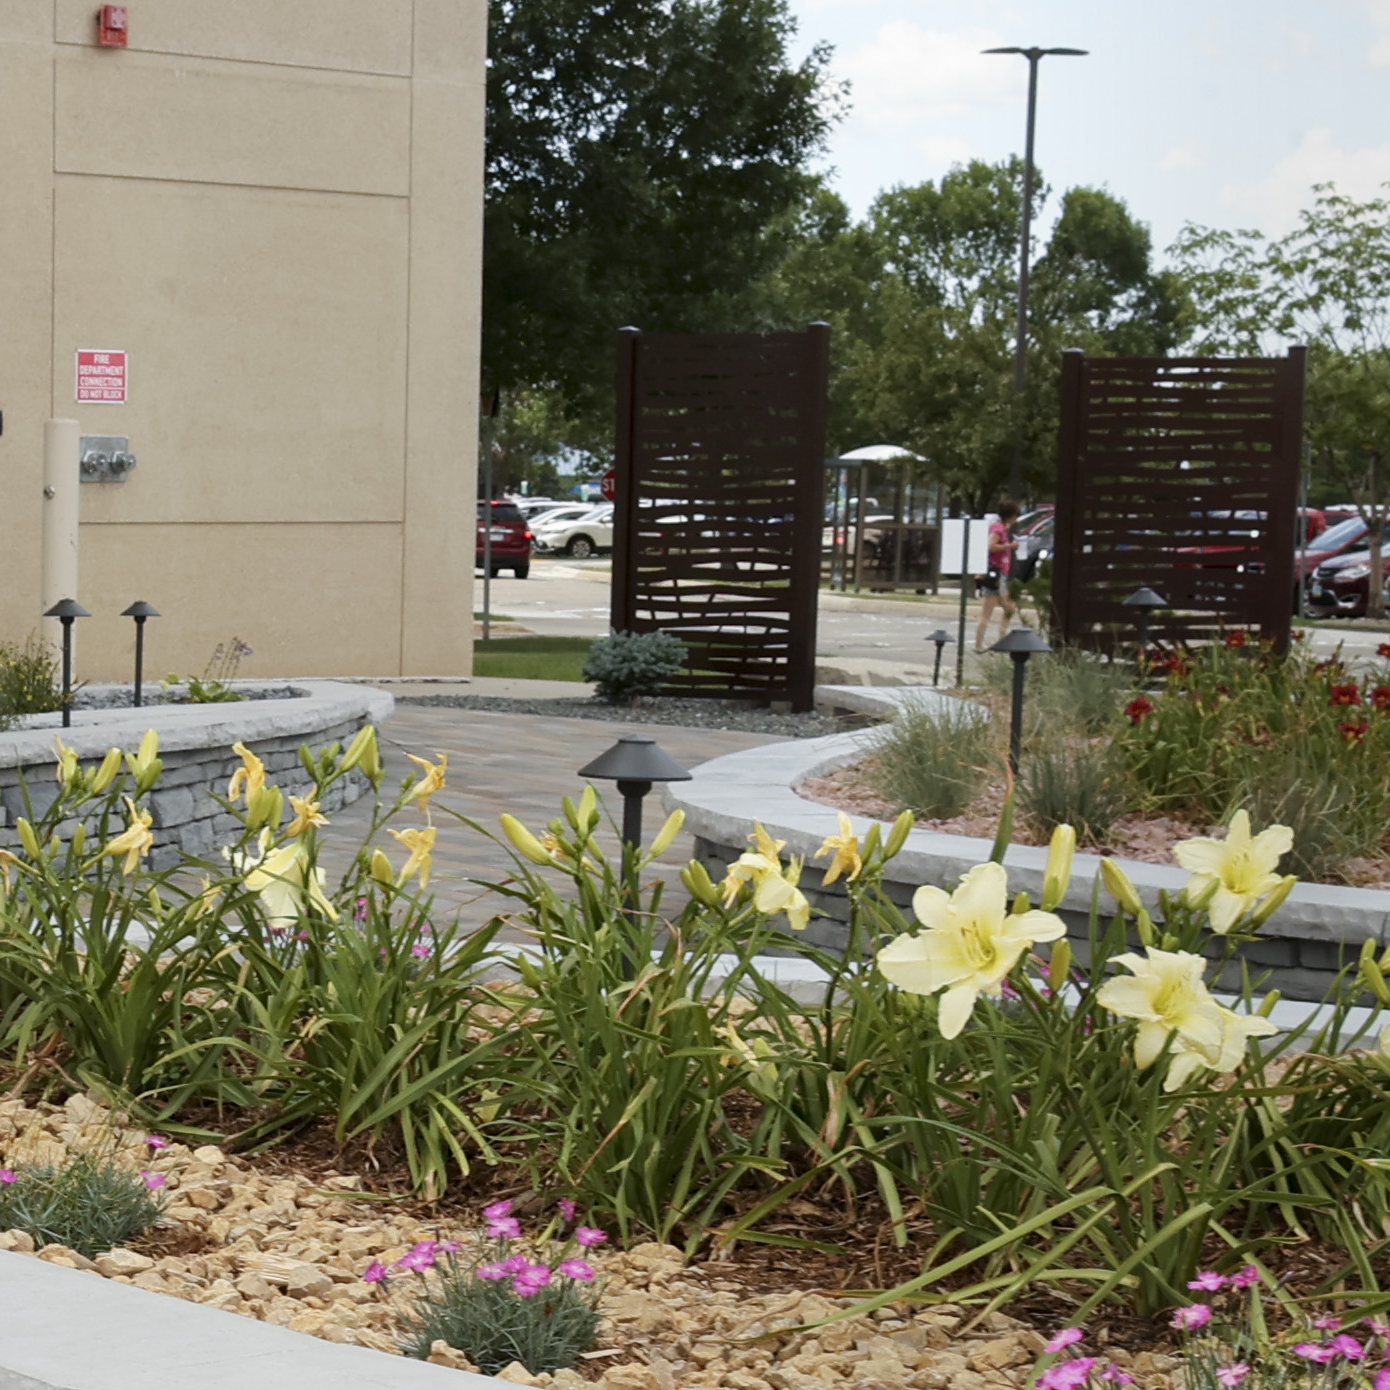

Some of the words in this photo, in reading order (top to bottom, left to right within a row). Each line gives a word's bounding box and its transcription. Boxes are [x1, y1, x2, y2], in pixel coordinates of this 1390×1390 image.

[93, 354, 110, 364] FIRE
[79, 364, 124, 376] DEPARTMENT
[79, 376, 123, 387] CONNECTION
[79, 389, 89, 399] DO
[90, 389, 102, 399] NOT
[103, 389, 123, 399] BLOCK
[602, 478, 616, 493] ST
